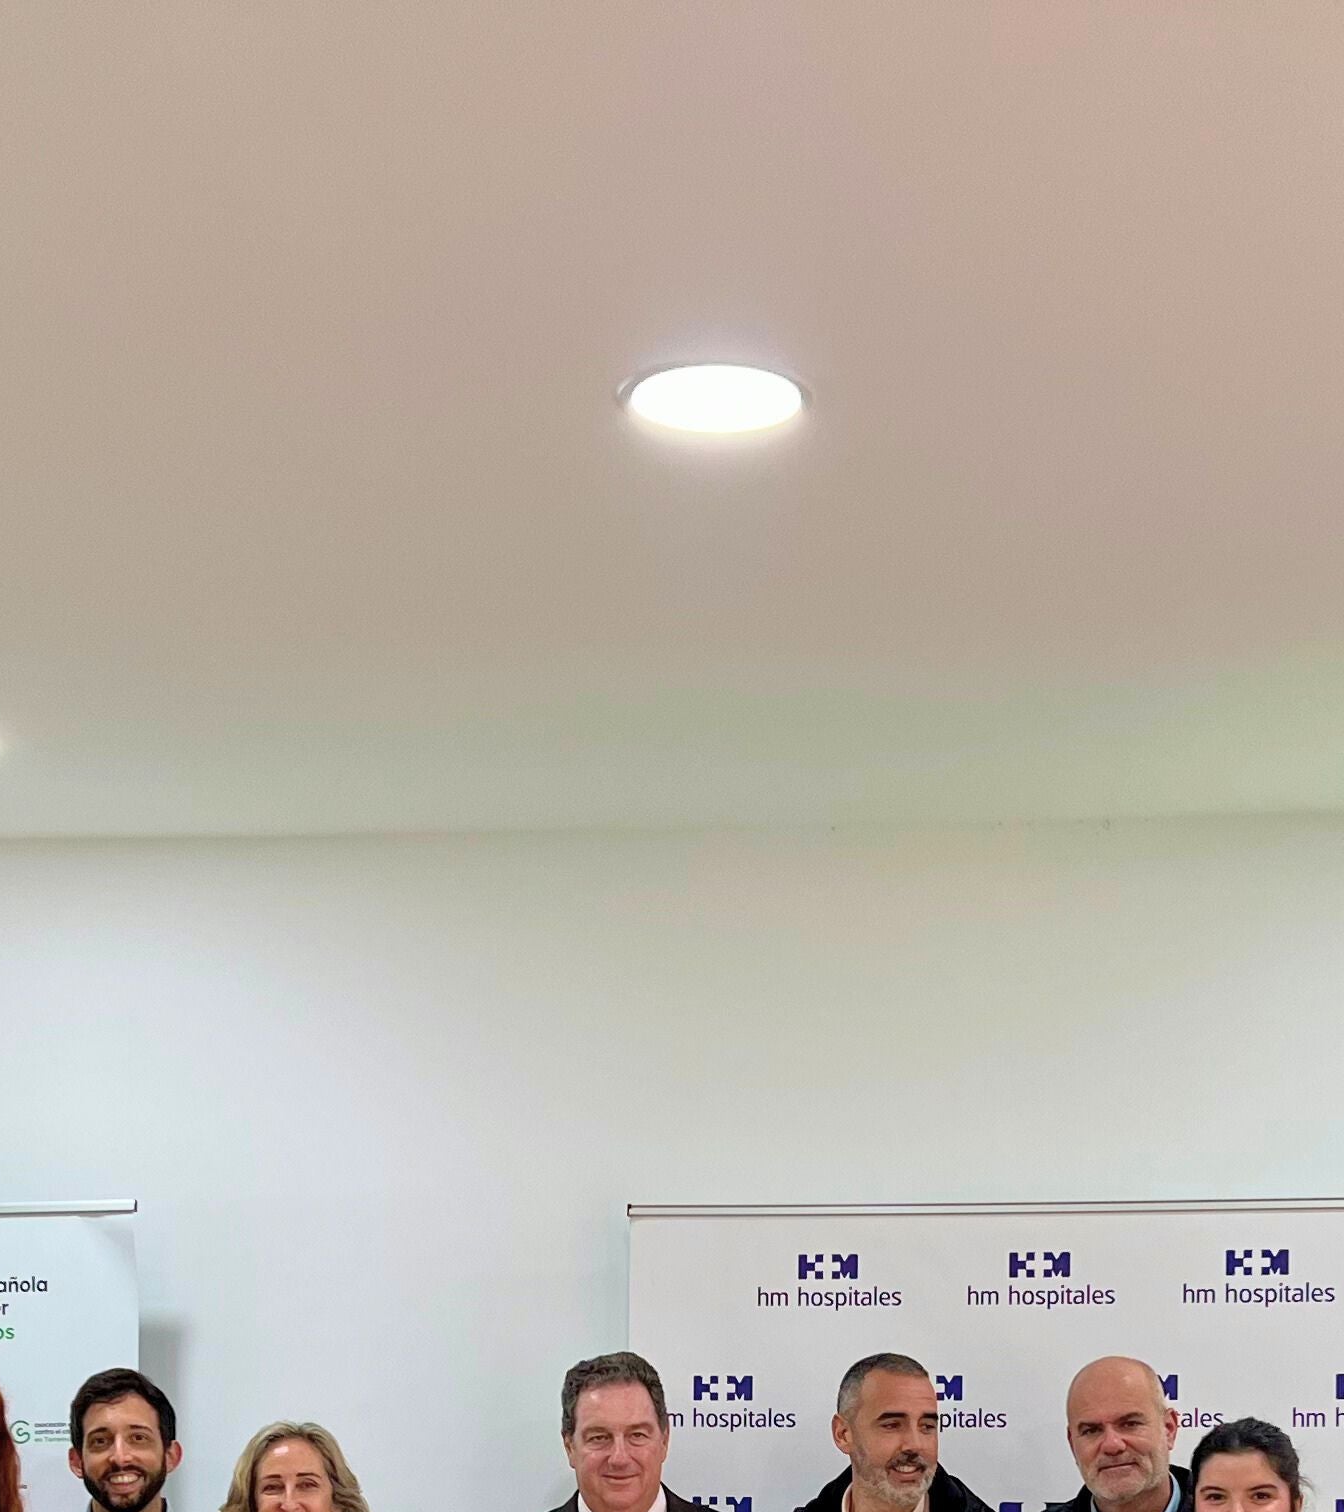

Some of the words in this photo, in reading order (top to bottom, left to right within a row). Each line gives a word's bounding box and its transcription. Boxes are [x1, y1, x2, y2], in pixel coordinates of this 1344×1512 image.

[757, 1286, 789, 1307] hm
[798, 1286, 902, 1311] hospitales
[967, 1284, 999, 1306] hm
[1008, 1284, 1116, 1309] hospitales
[1182, 1282, 1216, 1304] hm
[1225, 1282, 1336, 1307] hospitales
[693, 1407, 796, 1432] hospitales
[938, 1407, 1007, 1432] pitales
[1292, 1407, 1326, 1428] hm
